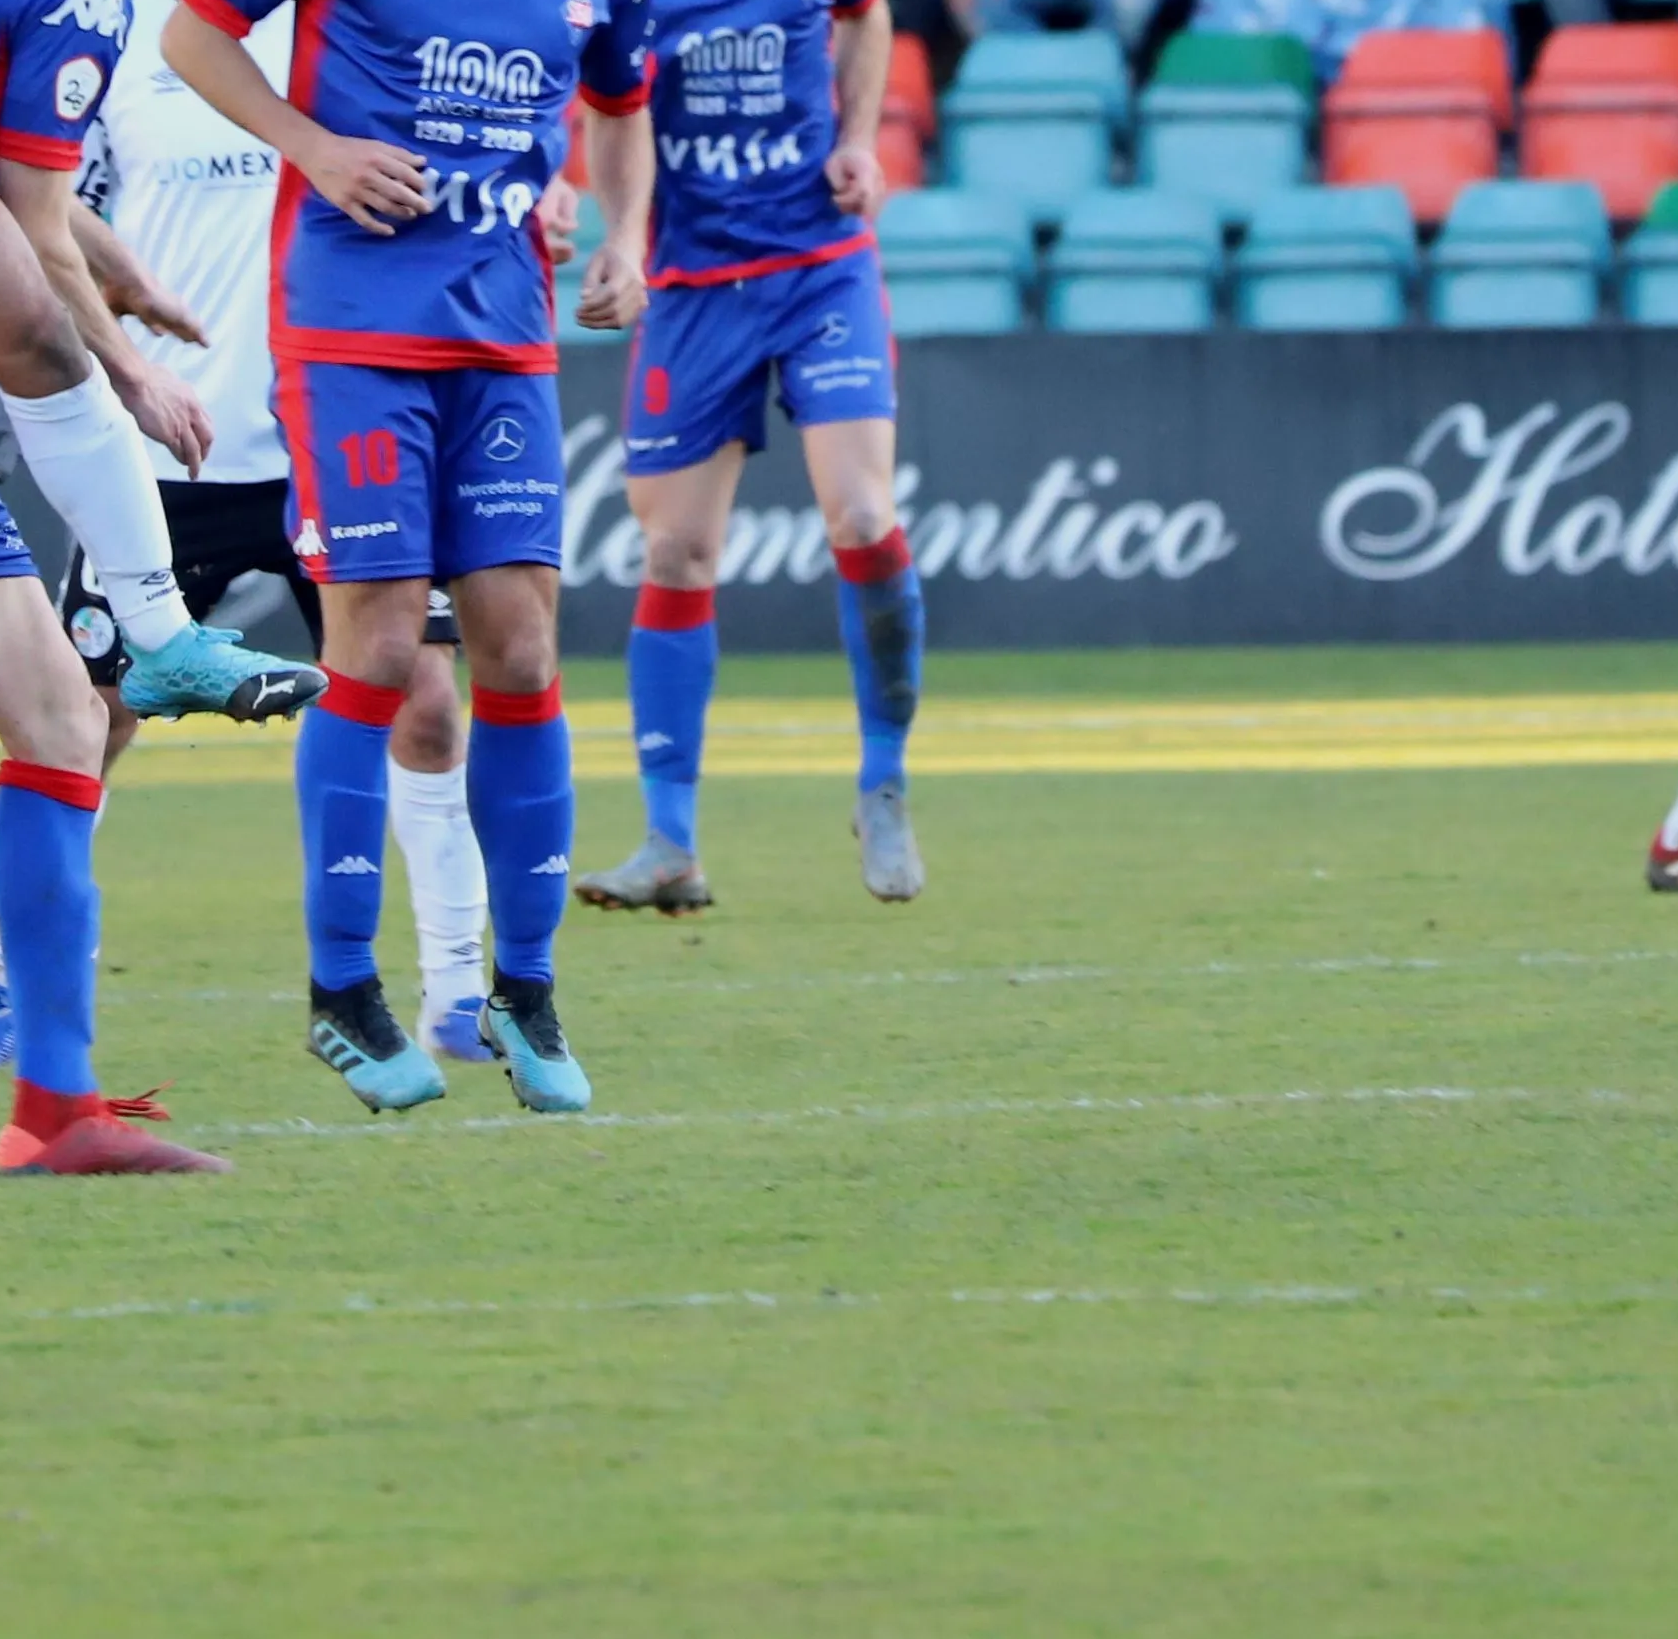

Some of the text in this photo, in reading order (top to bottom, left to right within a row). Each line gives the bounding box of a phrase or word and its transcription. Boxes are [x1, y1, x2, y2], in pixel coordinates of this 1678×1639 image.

[338, 428, 400, 489] 10
[458, 478, 560, 499] Mercedes-Benz
[473, 499, 544, 519] Aguinaga
[330, 520, 399, 541] Kappa
